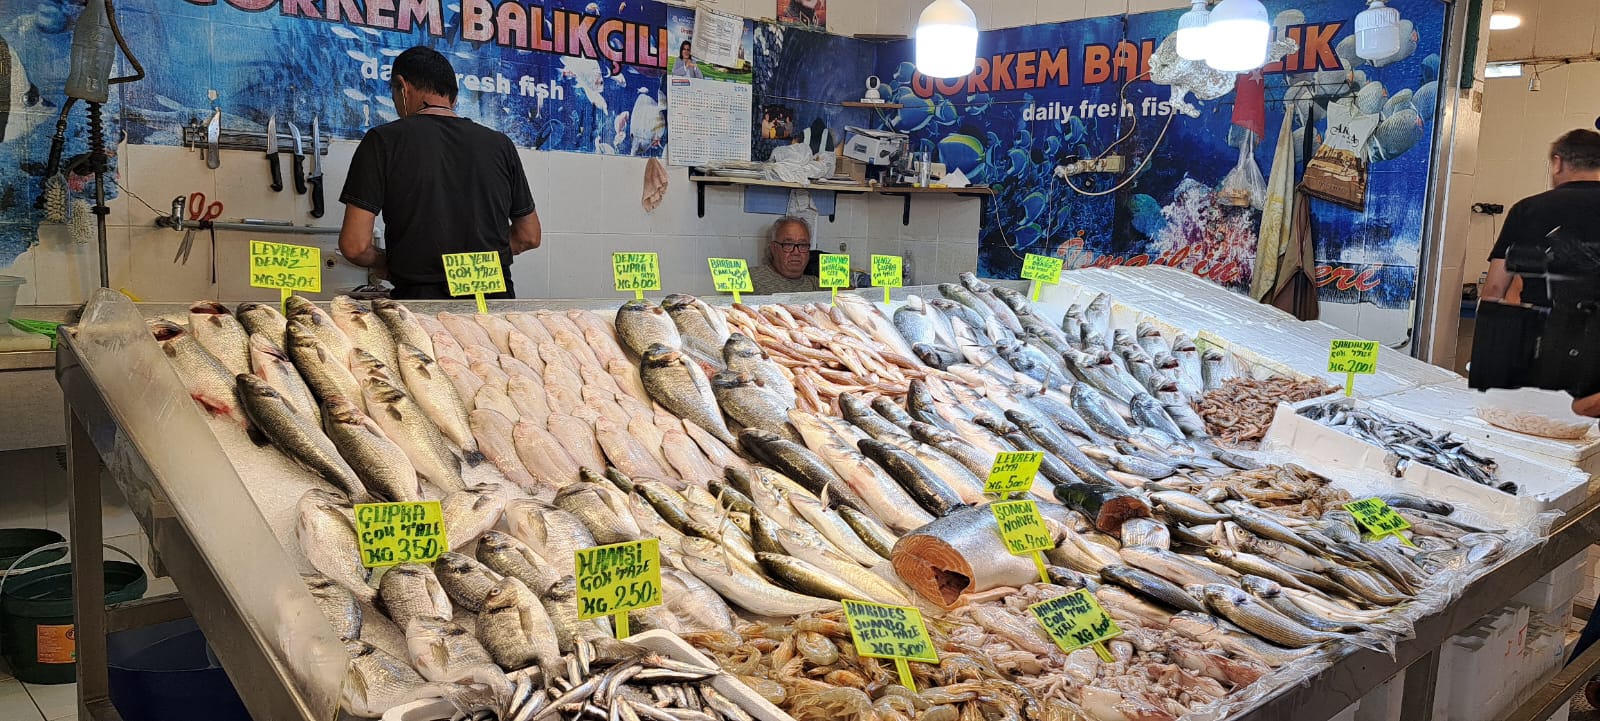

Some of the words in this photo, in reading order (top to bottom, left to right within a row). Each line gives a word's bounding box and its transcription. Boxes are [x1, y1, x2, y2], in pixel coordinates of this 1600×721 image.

[455, 73, 511, 95] resh
[518, 75, 564, 100] fish
[1023, 99, 1074, 124] daily
[252, 242, 310, 259] LEVREK
[997, 452, 1038, 464] LEVREK
[358, 504, 426, 529] ÇUPRA
[996, 502, 1033, 520] SOMON
[362, 526, 395, 544] ÇOK
[580, 571, 612, 593] ÇOK
[615, 558, 652, 580] TAZE
